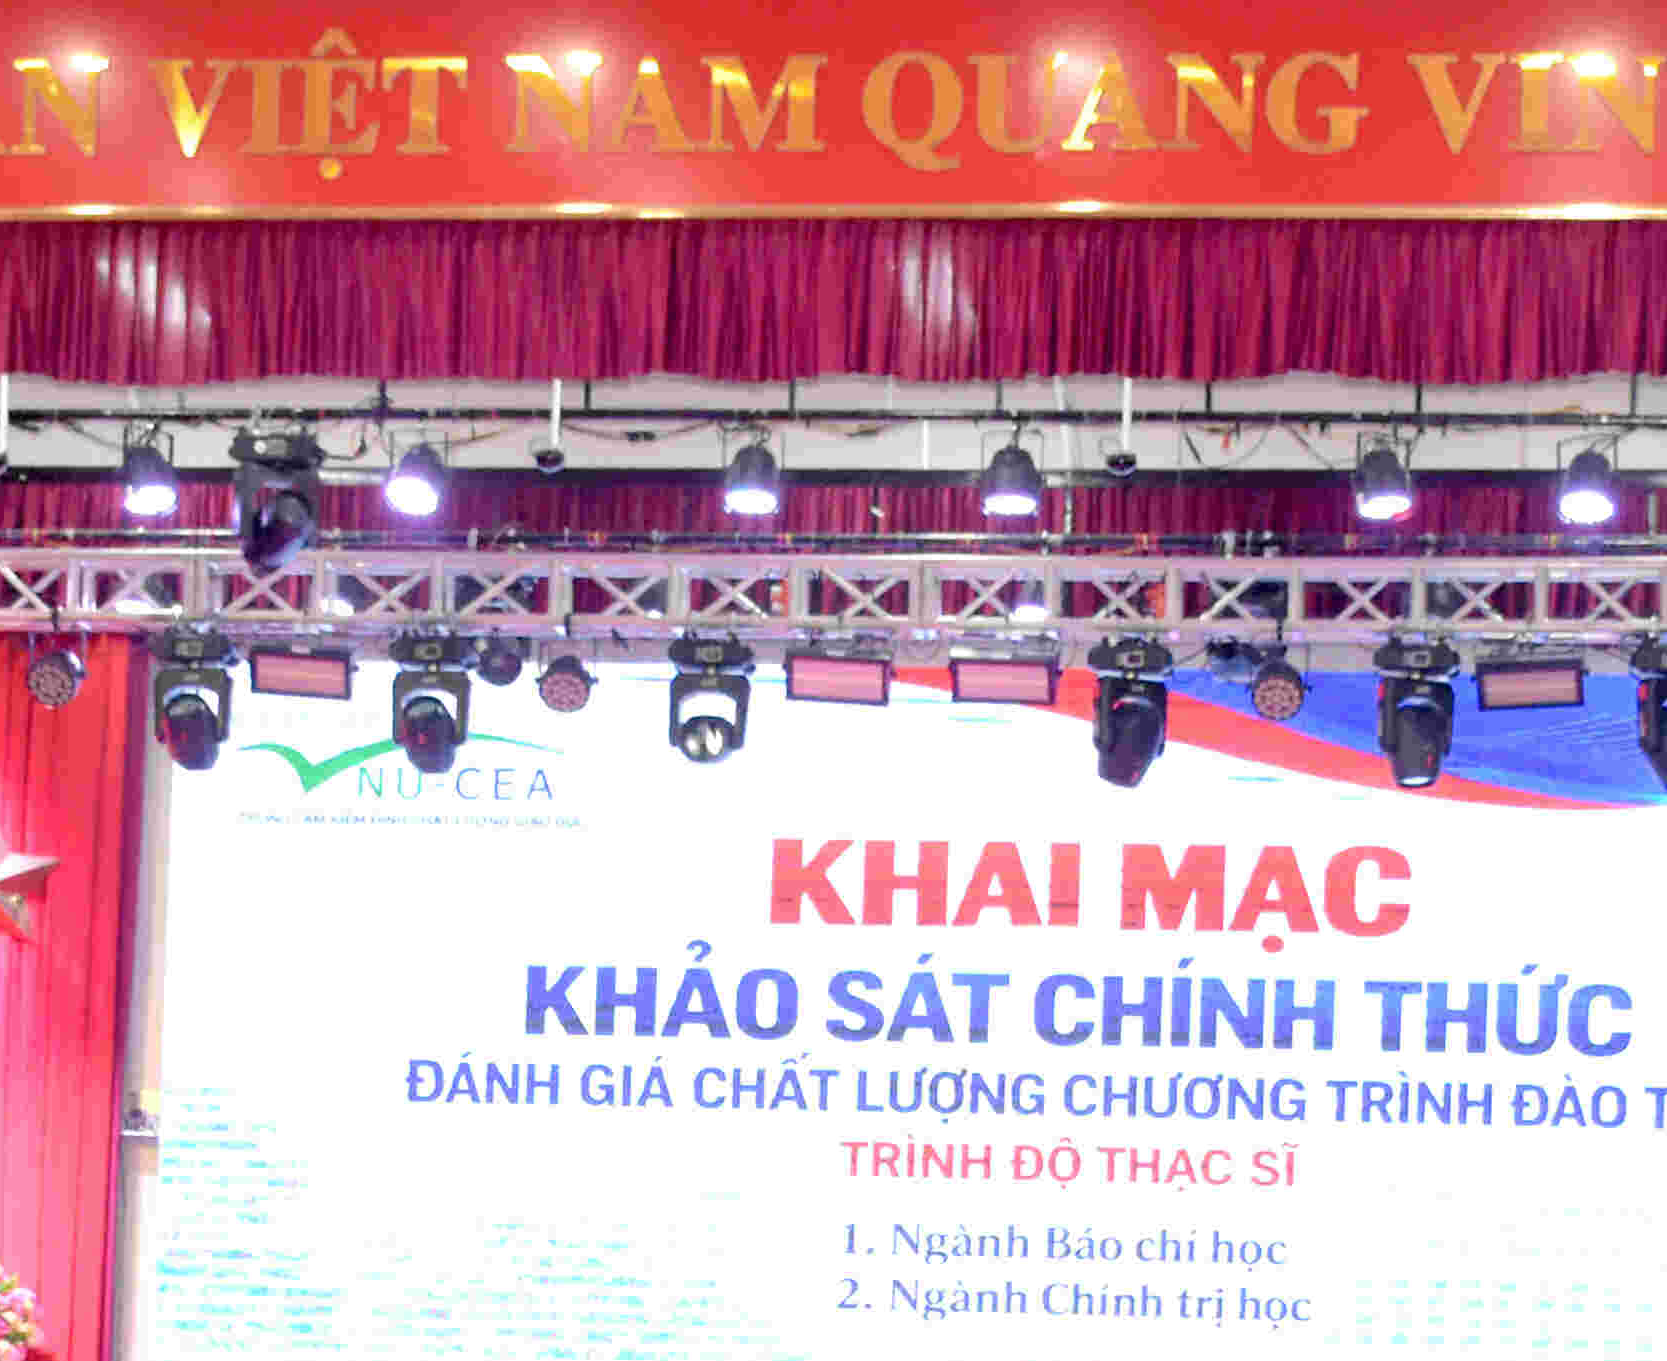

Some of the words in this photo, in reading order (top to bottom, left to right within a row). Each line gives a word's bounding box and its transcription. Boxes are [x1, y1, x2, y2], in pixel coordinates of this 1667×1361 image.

[151, 35, 468, 180] VIỆT
[507, 50, 827, 157] NAM
[860, 50, 1368, 172] QUANG
[356, 767, 554, 801] NU-CEA
[769, 838, 1081, 930] KHAI
[1119, 842, 1413, 954] MẠC
[523, 940, 798, 1043] KHẢO
[826, 953, 1010, 1044] SÁT
[1033, 957, 1335, 1052] CHÍNH
[1363, 964, 1634, 1058] THỨC
[405, 1051, 561, 1109] ĐÁNH
[579, 1057, 673, 1108] GIÁ
[692, 1053, 839, 1112] CHẤT
[857, 1066, 1045, 1124] LƯỢNG
[1062, 1074, 1307, 1121] CHƯƠNG
[1326, 1072, 1494, 1126] TRÌNH
[1510, 1074, 1627, 1130] ĐÀO
[841, 1135, 993, 1180] TRÌNH
[1012, 1139, 1082, 1188] ĐỘ
[1097, 1146, 1232, 1192] THẠC
[1250, 1142, 1300, 1188] SĨ
[843, 1223, 875, 1254] 1.
[892, 1223, 1029, 1265] Ngành
[1043, 1224, 1123, 1261] Báo
[1212, 1229, 1287, 1273] học
[836, 1278, 873, 1310] 2.
[892, 1278, 1029, 1321] Ngành
[1177, 1286, 1224, 1329] trị
[1238, 1288, 1312, 1331] học
